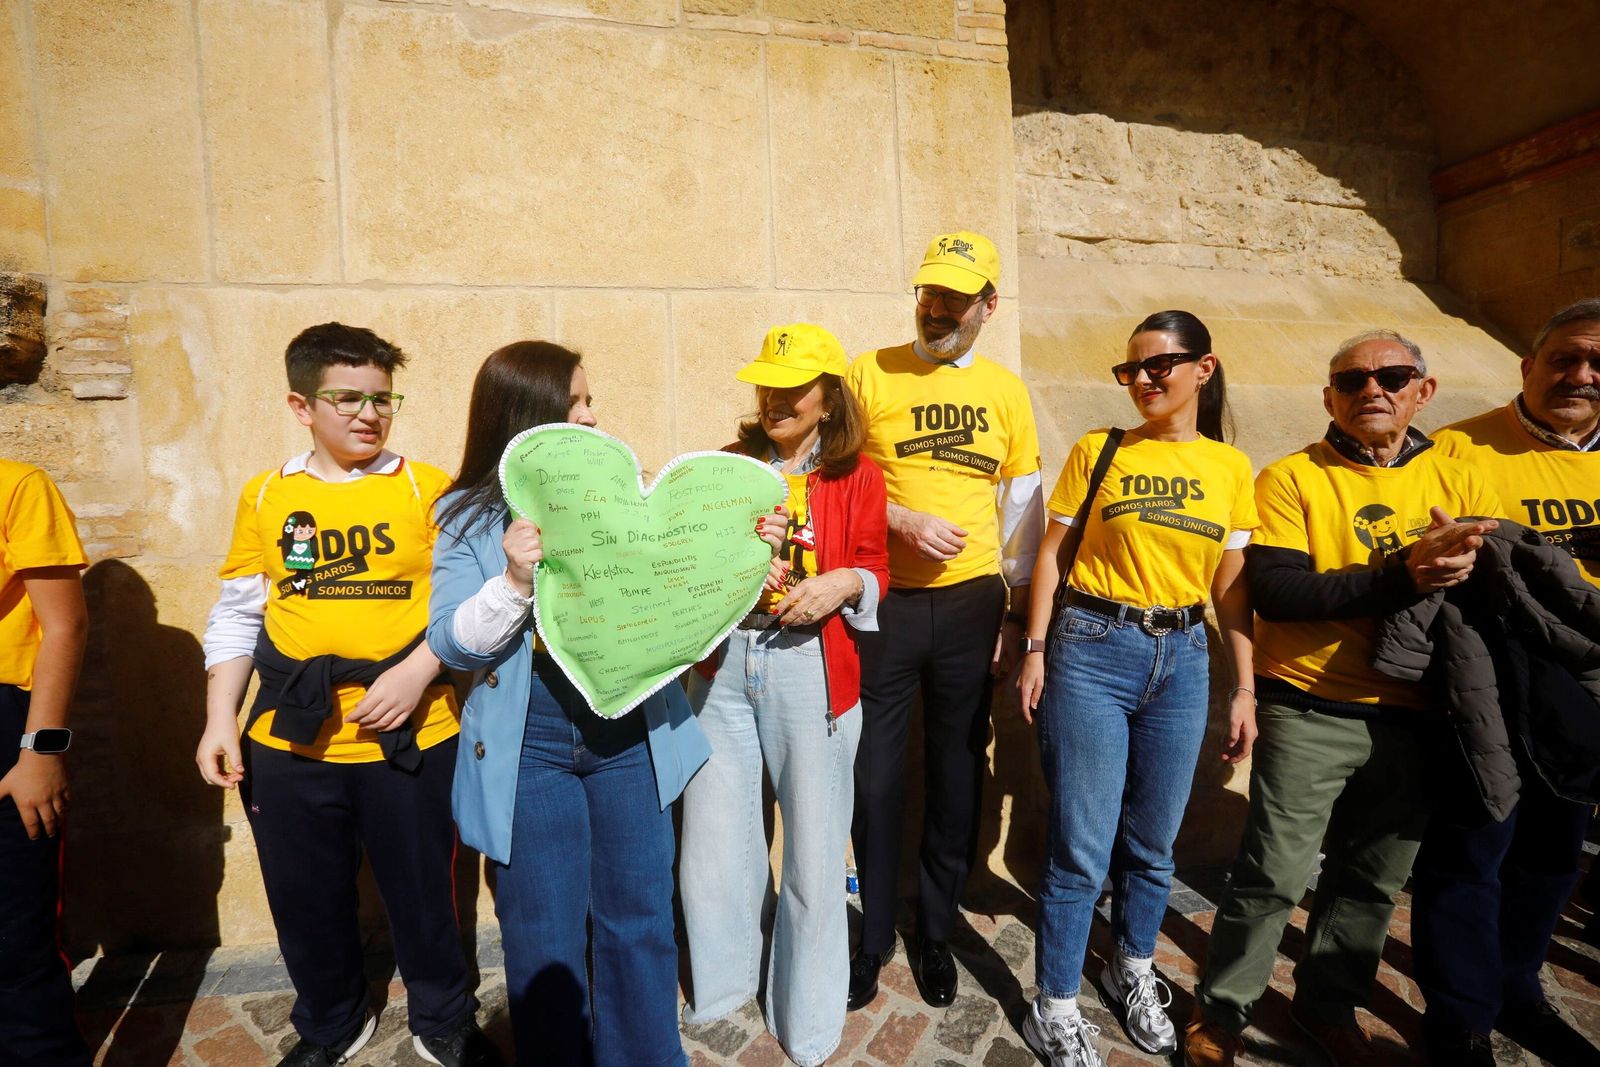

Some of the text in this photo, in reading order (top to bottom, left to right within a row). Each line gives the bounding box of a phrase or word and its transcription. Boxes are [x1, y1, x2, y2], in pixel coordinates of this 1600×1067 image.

[911, 404, 989, 432] TODOS
[904, 434, 965, 453] SOMOS RAROS
[939, 450, 969, 463] SOMOS
[970, 456, 995, 472] ÚNICOS
[1120, 474, 1205, 501] TODOS
[702, 496, 753, 512] ANGELMAN
[1108, 500, 1176, 515] SOMOS RAROS
[1521, 498, 1600, 527] TOD
[1147, 512, 1220, 537] SOMOS ÚNICOS
[277, 522, 396, 562] DOS
[315, 562, 356, 582] RAROS
[317, 583, 407, 596] SOMOS ÚNICOS
